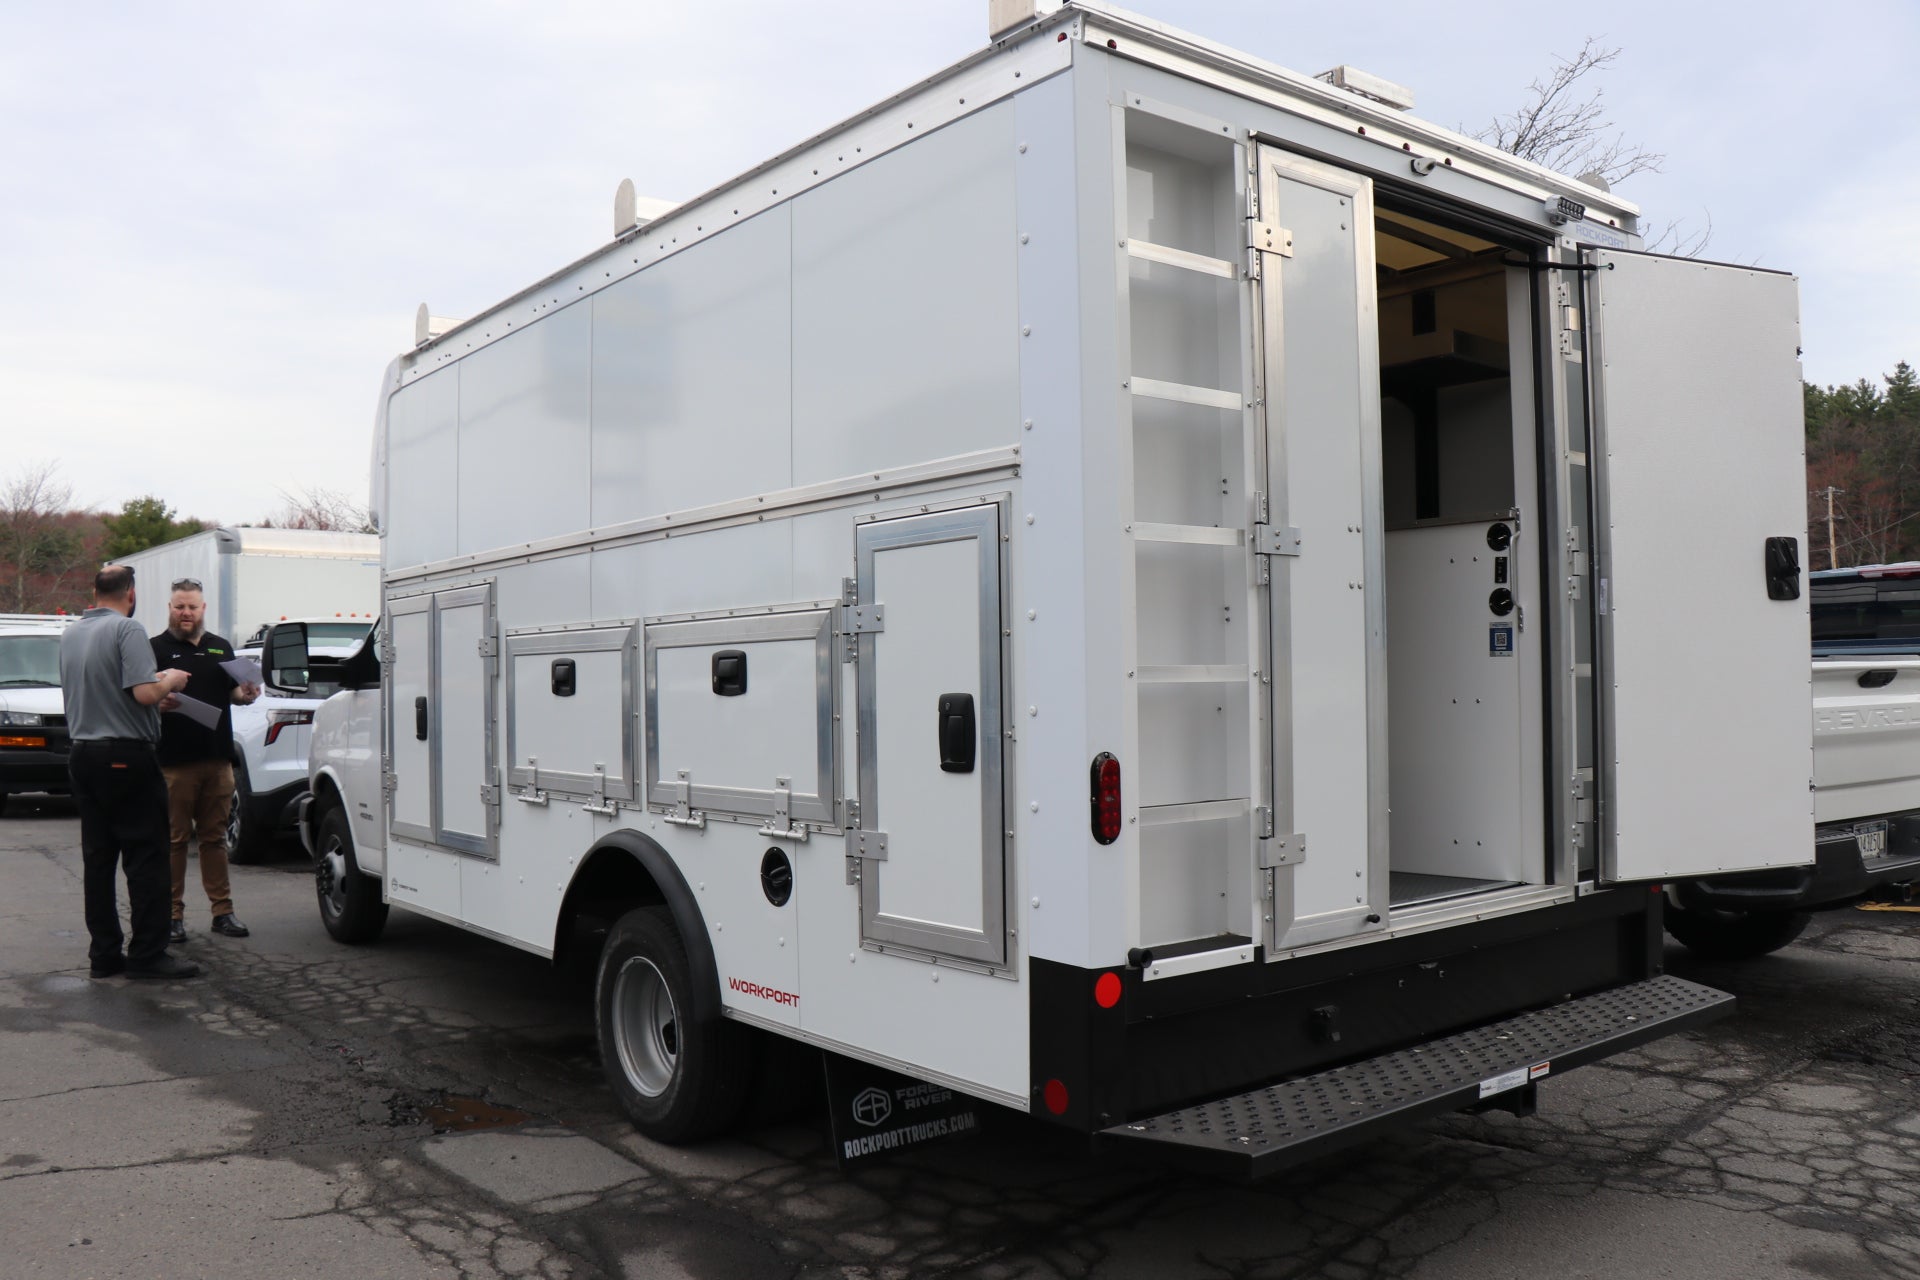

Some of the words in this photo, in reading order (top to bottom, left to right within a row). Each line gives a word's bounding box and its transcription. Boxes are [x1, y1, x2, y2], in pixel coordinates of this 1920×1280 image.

[1576, 223, 1625, 249] ROCKPORT
[1815, 706, 1920, 731] HEVROL
[728, 976, 800, 1008] WORKPORT
[895, 1083, 945, 1101] FORE
[904, 1090, 952, 1110] RIVER
[844, 1111, 976, 1159] ROCKPORTTRUCKS.COM
